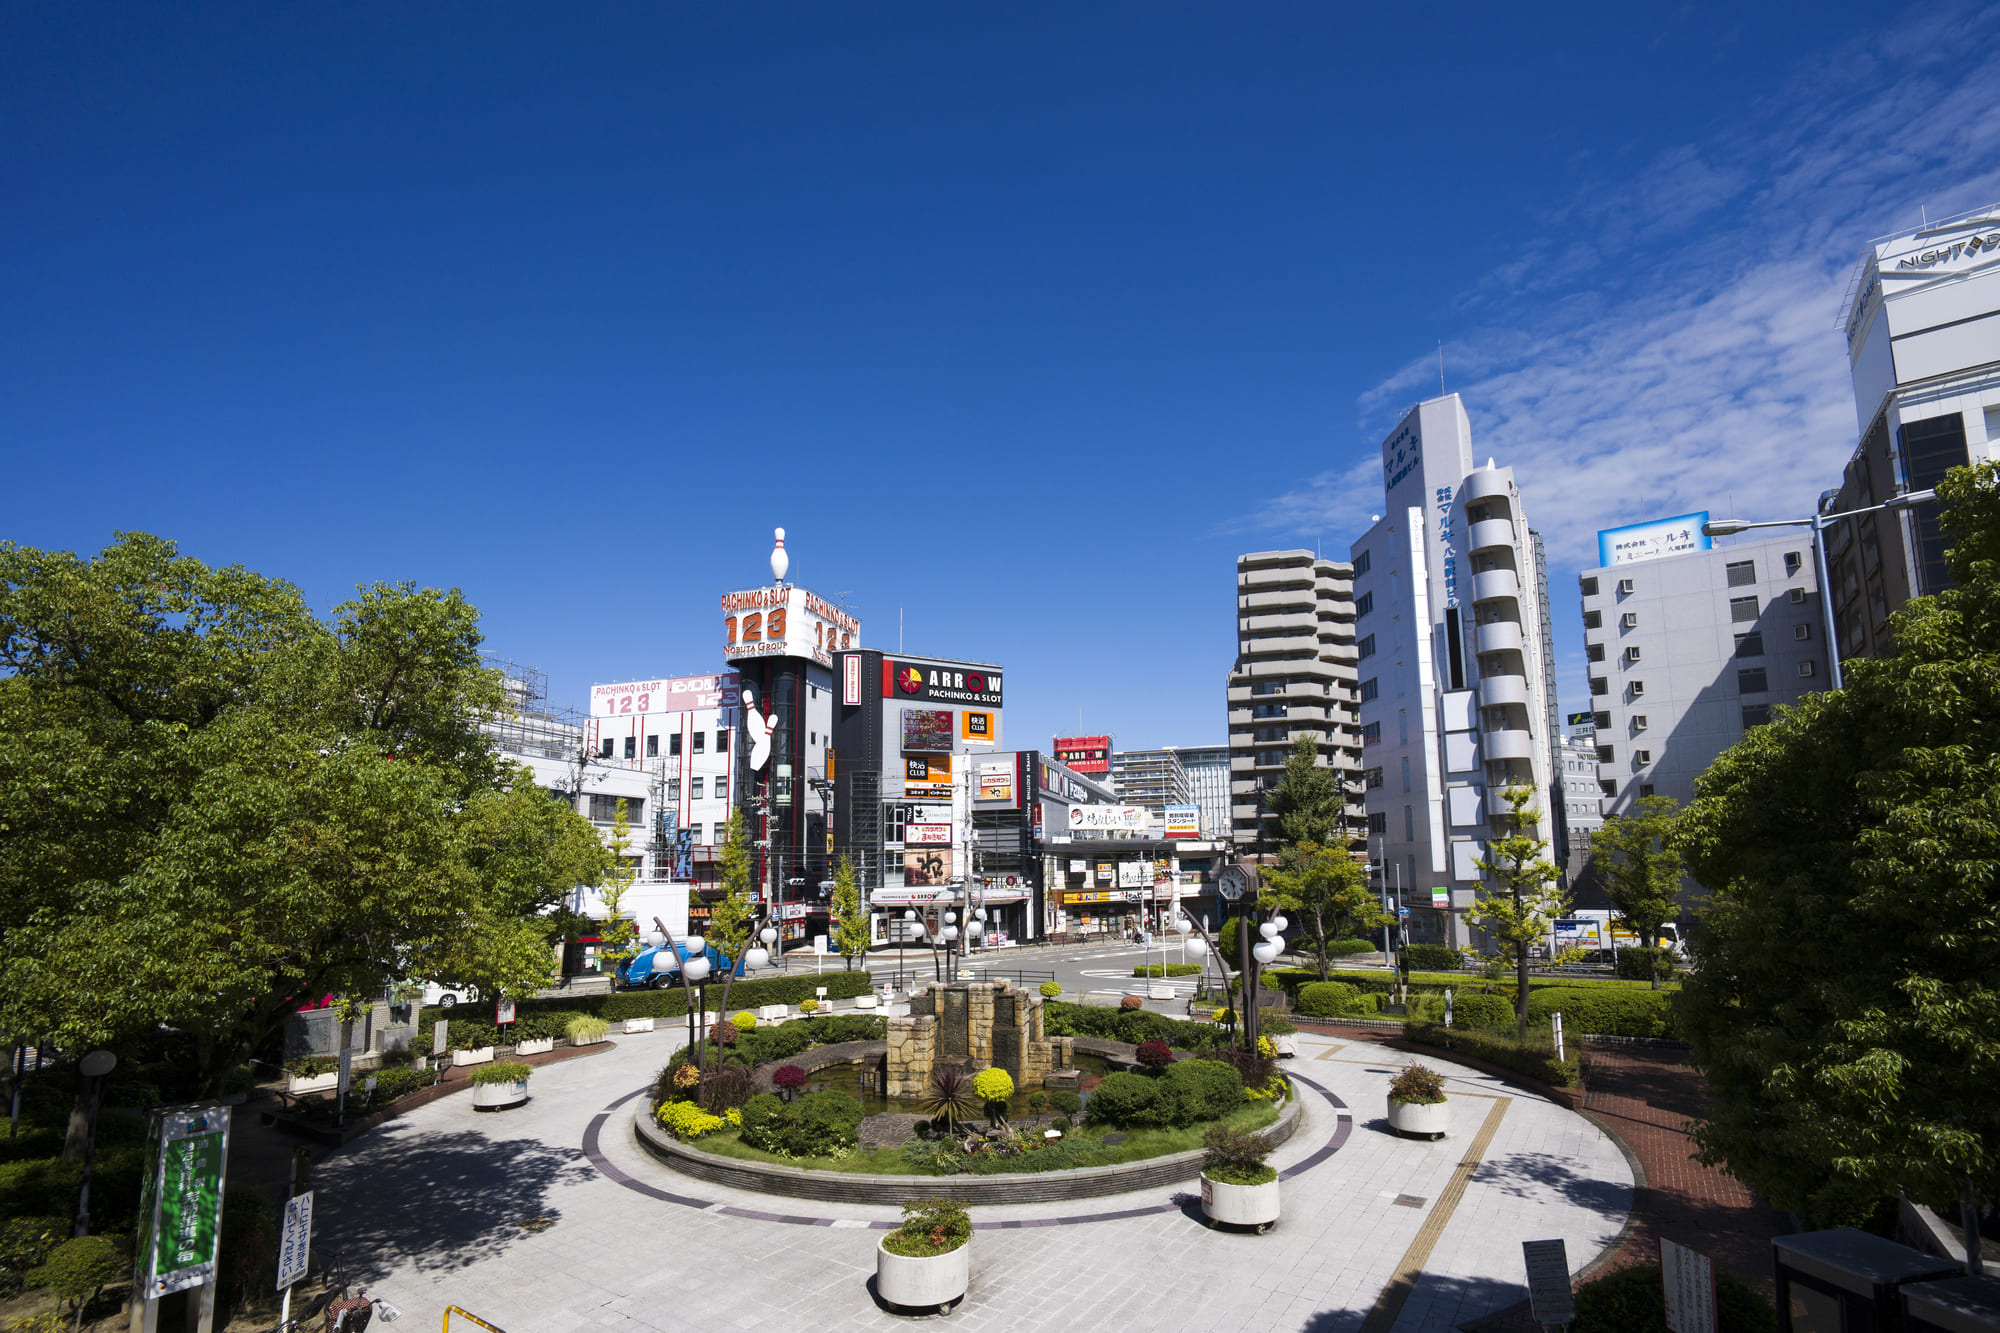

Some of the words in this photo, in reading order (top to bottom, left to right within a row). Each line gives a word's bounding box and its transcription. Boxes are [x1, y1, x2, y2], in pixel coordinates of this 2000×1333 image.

[1900, 242, 1966, 269] NIGHT
[1386, 436, 1418, 473] マルキ
[1616, 539, 1646, 550] 株式会社
[1650, 530, 1692, 546] マルキ
[721, 590, 762, 611] PACHINKO
[763, 593, 769, 605] &
[770, 588, 791, 605] SLOT
[805, 592, 839, 624] PACHINKO
[844, 615, 859, 636] SLOT
[725, 607, 786, 642] 123
[816, 622, 850, 650] 123
[596, 683, 635, 695] PACHINKO
[642, 681, 661, 691] SLOT
[671, 676, 738, 693] BOWL
[929, 670, 1001, 692] ARROW
[607, 693, 649, 714] 123
[695, 692, 738, 707] 123
[929, 689, 972, 701] PACHINKO
[982, 695, 1001, 703] SLOT
[1069, 751, 1103, 760] ARROW
[921, 833, 946, 842] まねきねこ
[1035, 827, 1041, 837] P
[991, 876, 1023, 888] ARROW
[1085, 893, 1098, 901] 松屋
